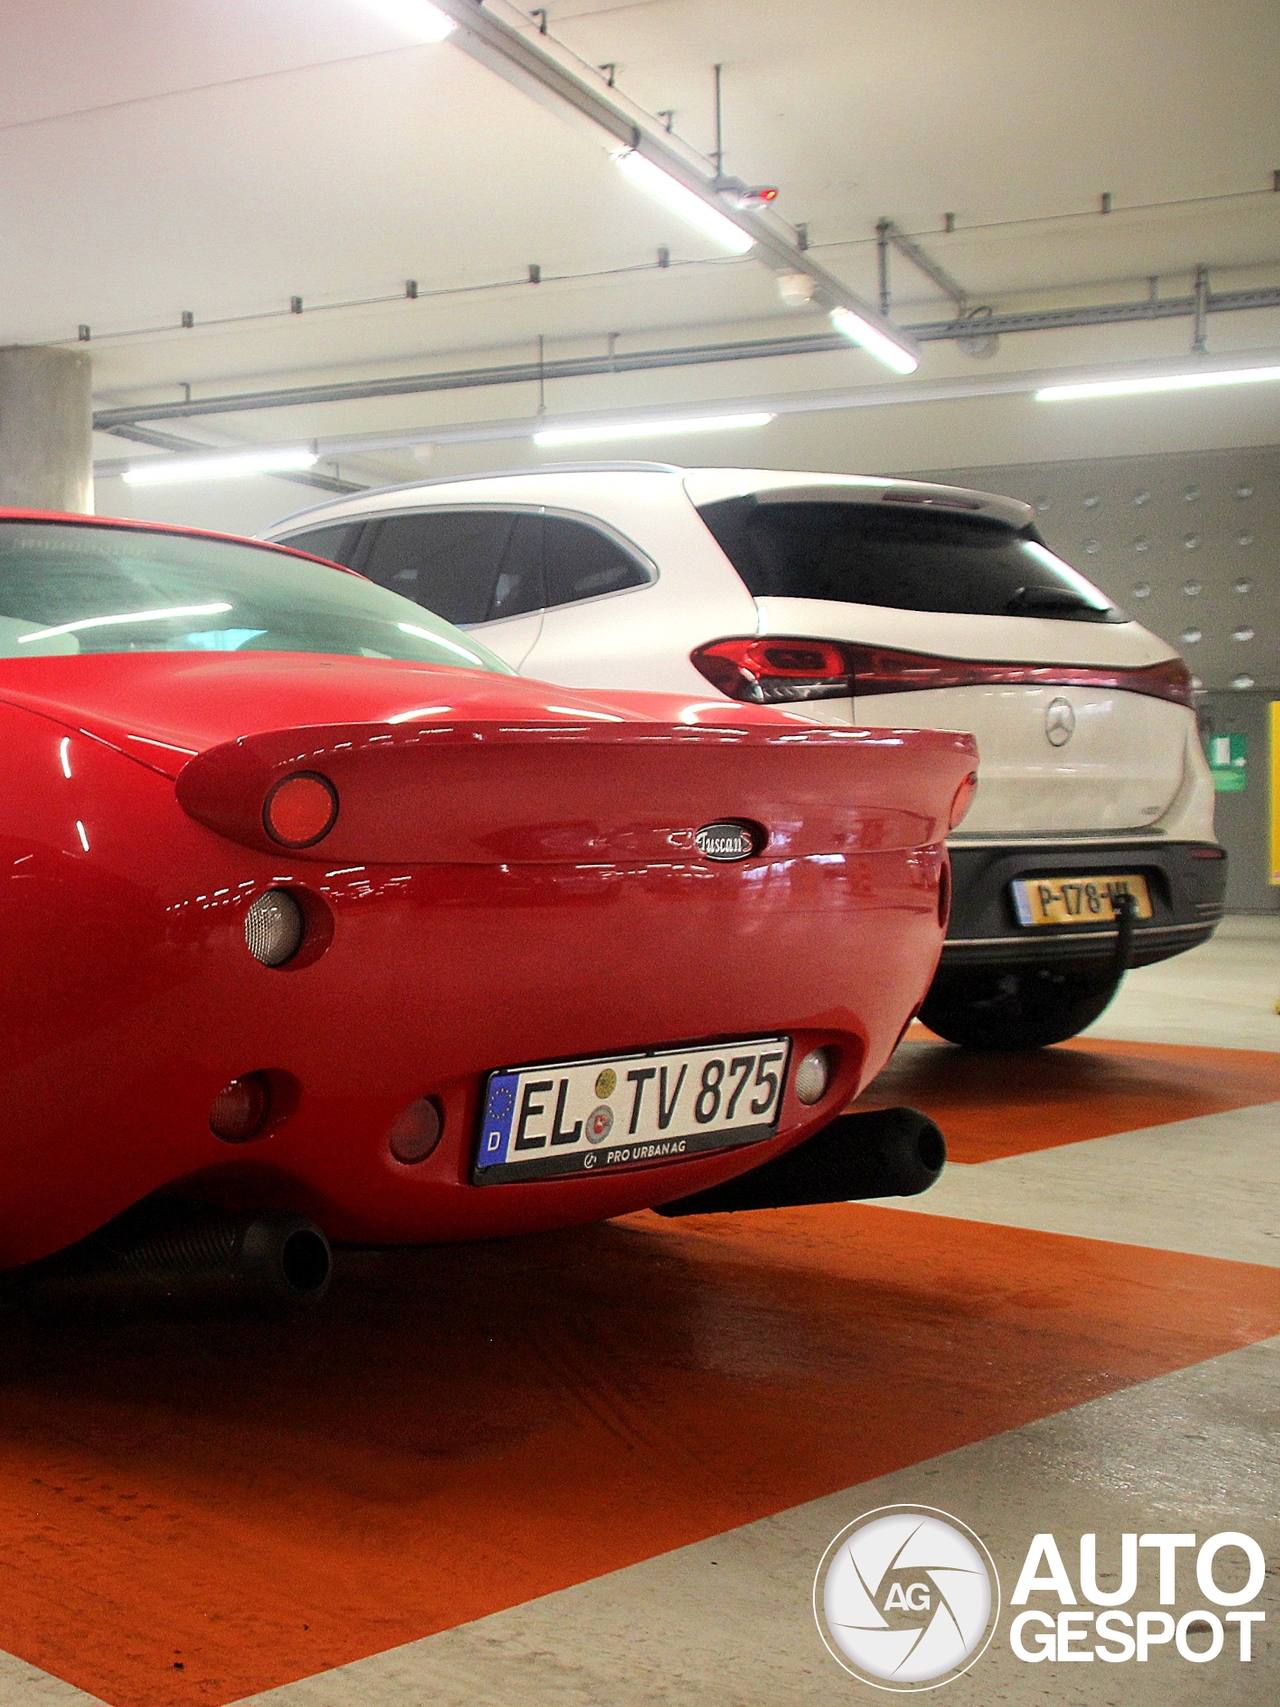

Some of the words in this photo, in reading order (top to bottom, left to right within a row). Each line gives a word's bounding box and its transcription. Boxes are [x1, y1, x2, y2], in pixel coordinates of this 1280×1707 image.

[695, 831, 742, 853] Tuscan
[1038, 881, 1131, 917] P-178-
[514, 1078, 583, 1151] EL
[627, 1063, 689, 1134] TV
[694, 1052, 783, 1124] 875
[486, 1131, 500, 1152] D
[606, 1149, 630, 1164] PRO
